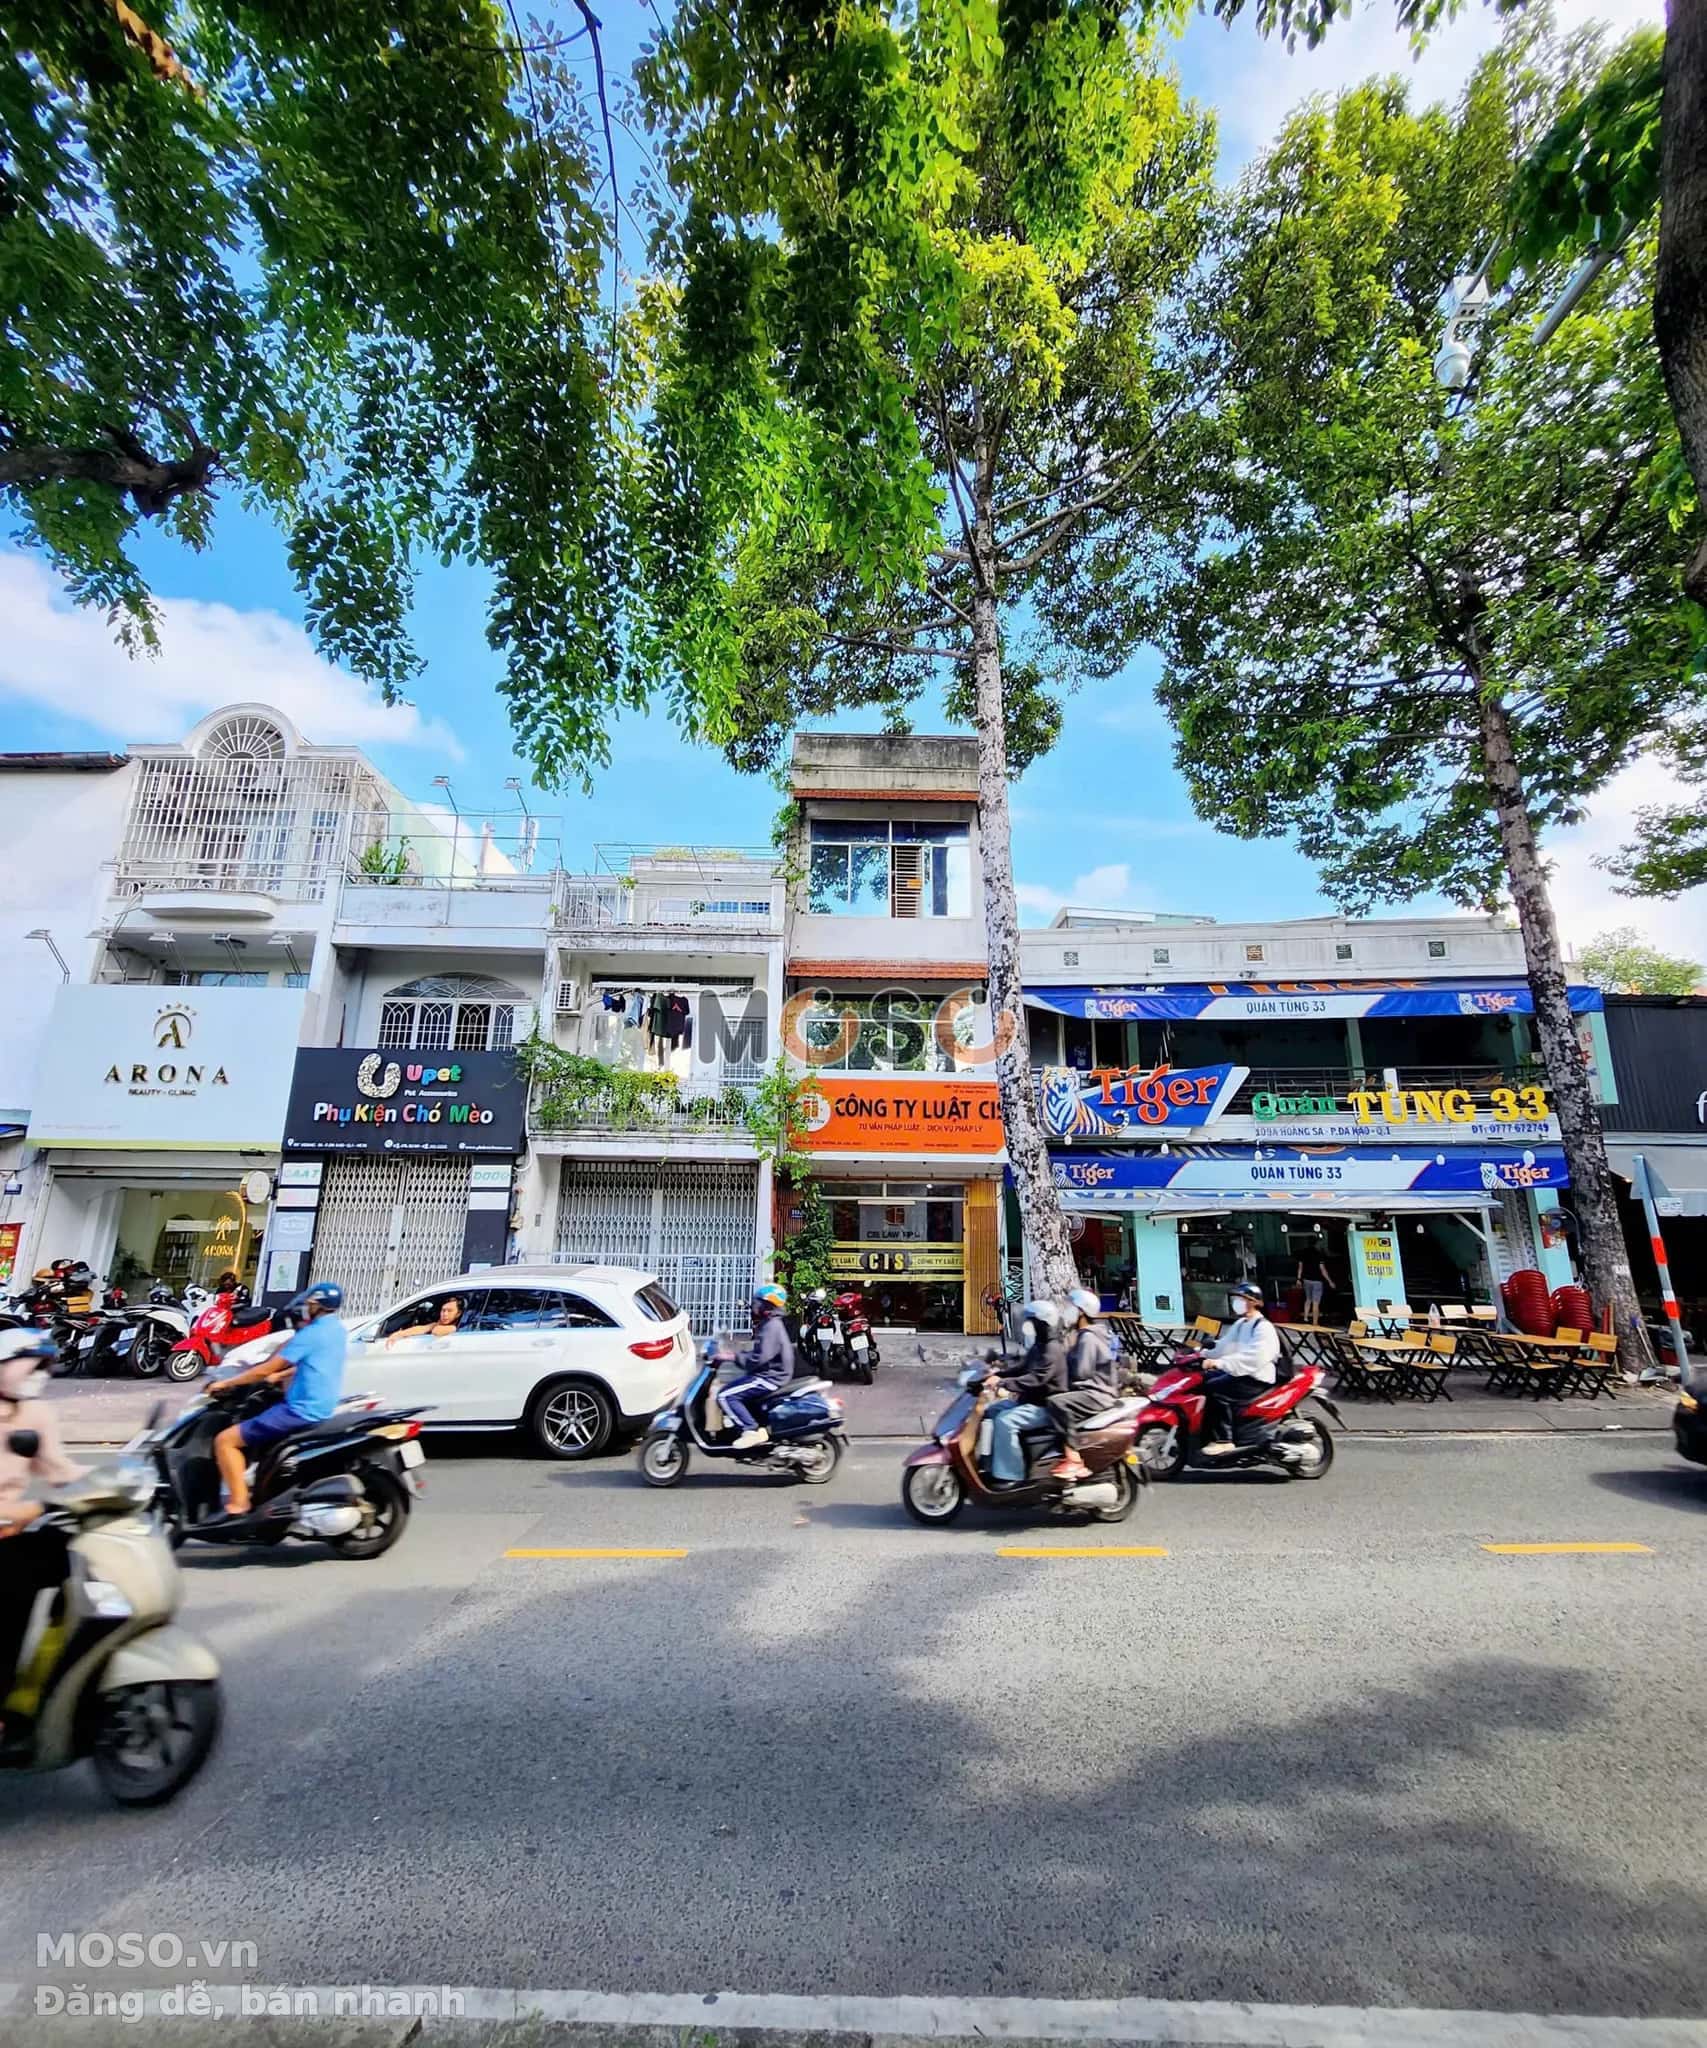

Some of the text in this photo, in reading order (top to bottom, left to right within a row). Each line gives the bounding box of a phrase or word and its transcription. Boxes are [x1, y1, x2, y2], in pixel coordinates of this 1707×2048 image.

[1099, 999, 1137, 1017] Tiger
[1246, 999, 1276, 1013] QUÁN
[1312, 1000, 1326, 1012] 33
[1474, 992, 1517, 1011] Tiger
[104, 1063, 229, 1084] ARONA
[406, 1064, 462, 1085] Upet
[1090, 1063, 1219, 1125] Tiger
[1252, 1083, 1549, 1125] Quán TÙNG 33
[313, 1102, 493, 1127] Phụ Kiện Chó Mèo
[835, 1093, 887, 1118] CÔNG
[893, 1100, 917, 1118] TY
[923, 1097, 971, 1123] LUẬT
[1313, 1127, 1324, 1136] SA
[1070, 1163, 1115, 1186] Tiger
[1251, 1164, 1285, 1180] QUÁN
[1327, 1167, 1342, 1179] 33
[1500, 1162, 1550, 1186] Tiger
[869, 1254, 905, 1270] CIS
